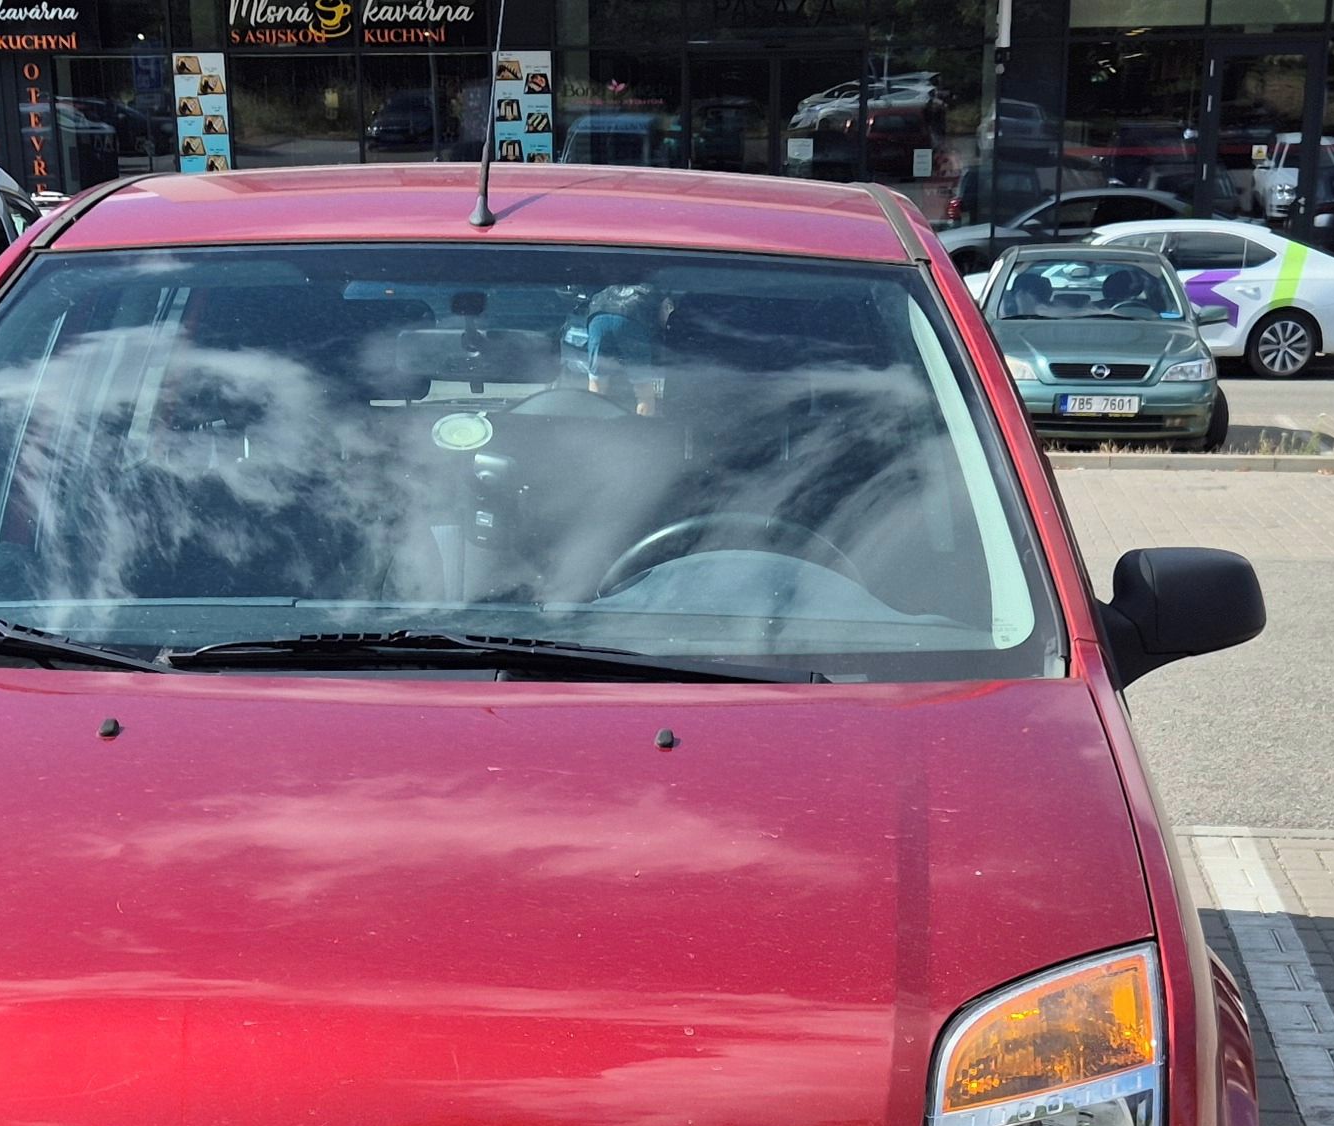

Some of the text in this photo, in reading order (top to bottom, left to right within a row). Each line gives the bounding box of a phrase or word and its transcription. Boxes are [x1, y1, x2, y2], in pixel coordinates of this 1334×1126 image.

[362, 0, 475, 24] kavárna
[230, 24, 446, 44] S ASIJSKOU KUCHYNÍ
[1071, 397, 1133, 411] 7B5 7601
